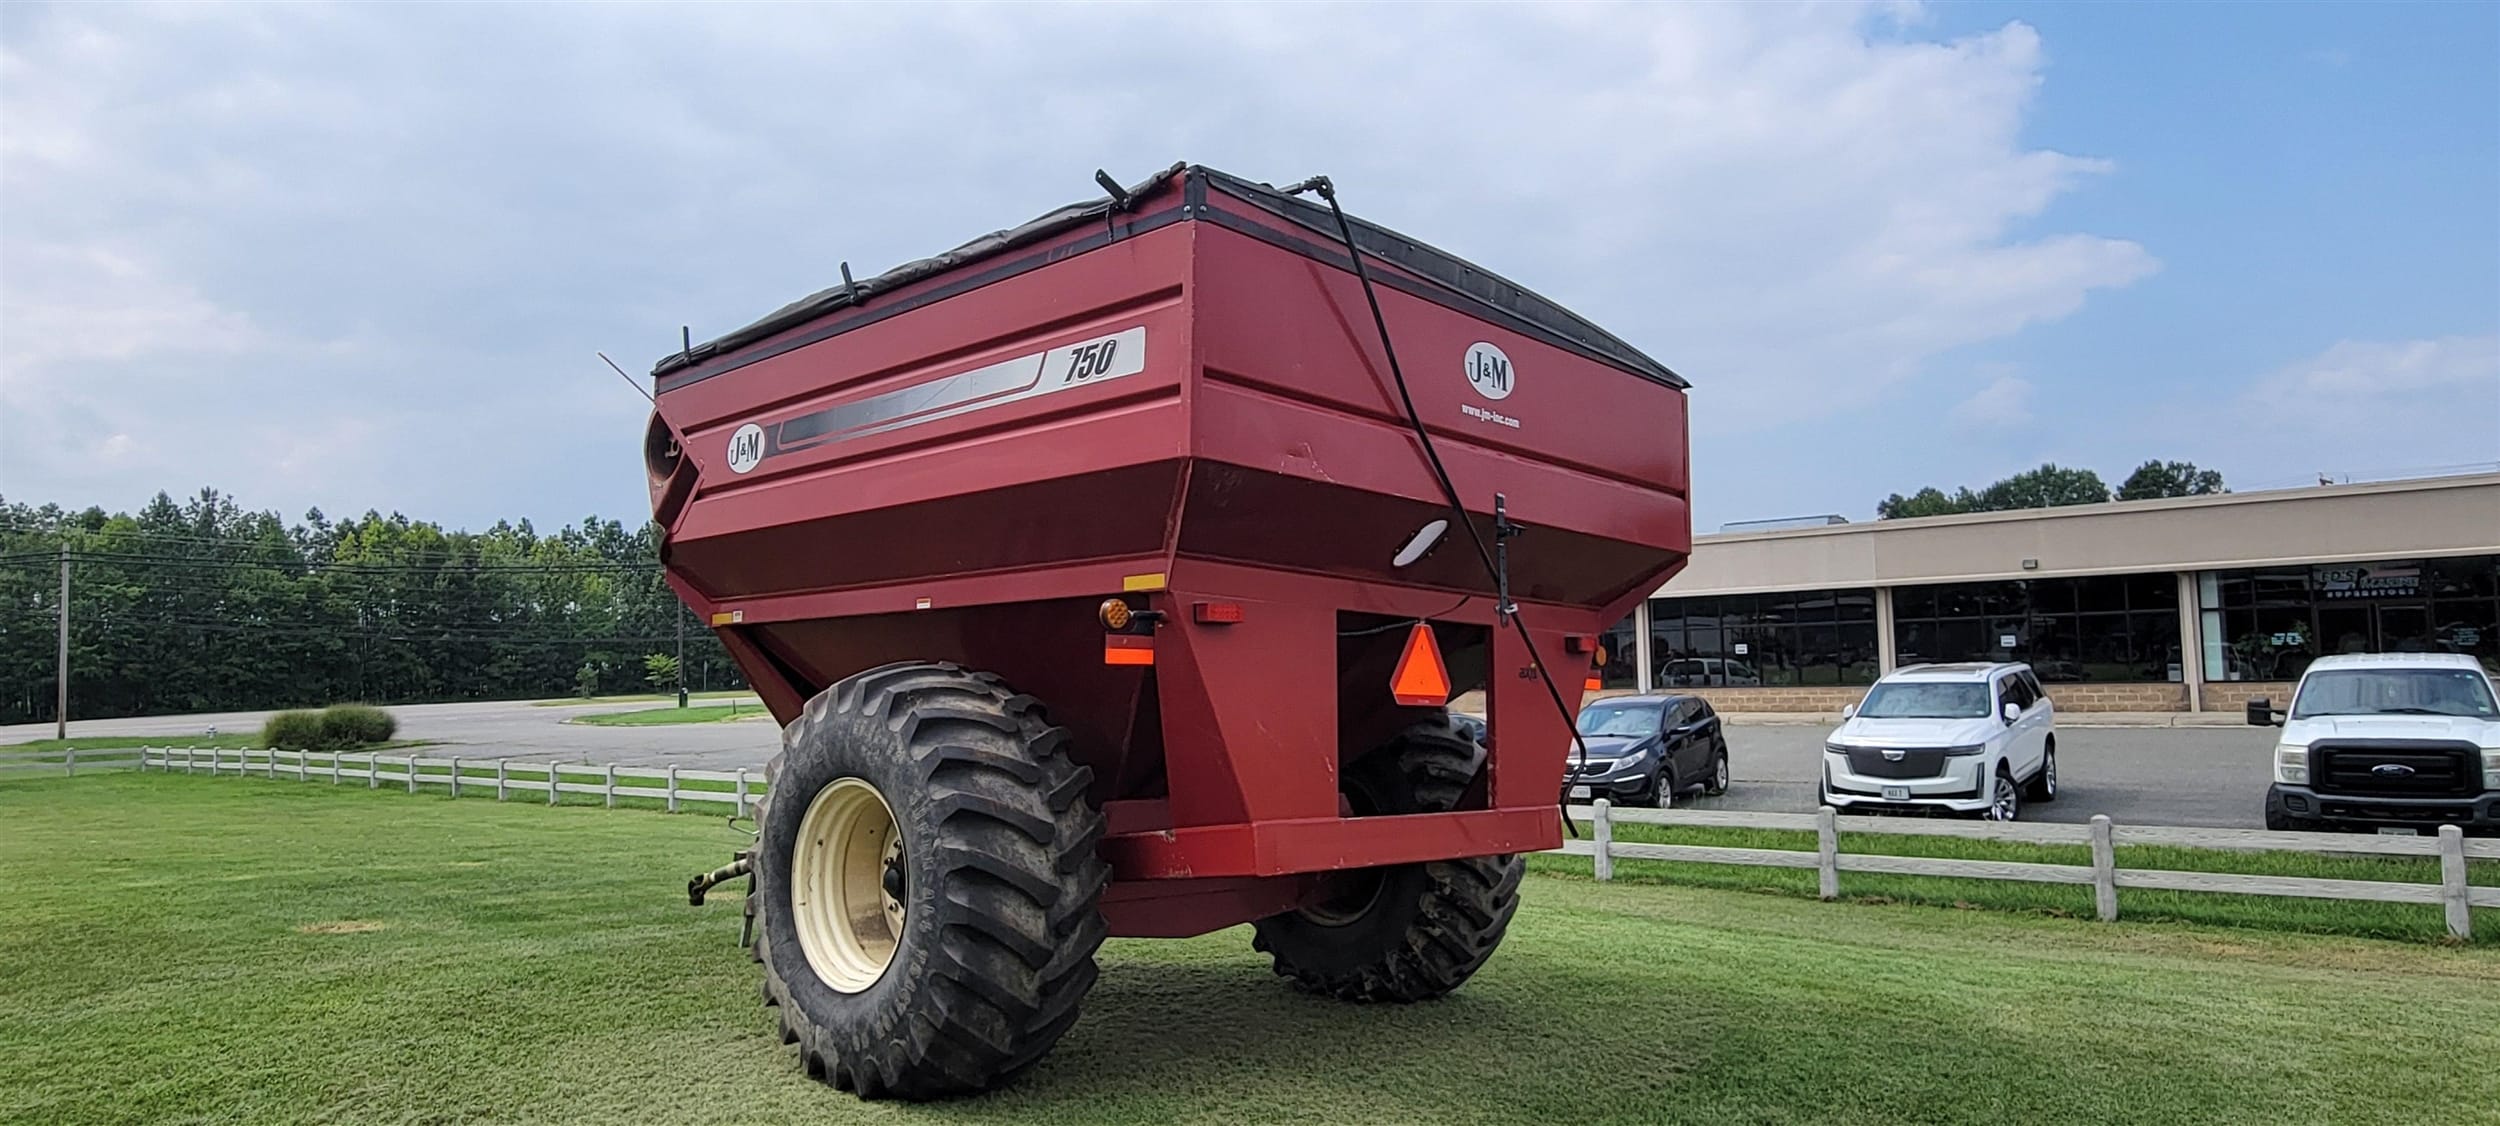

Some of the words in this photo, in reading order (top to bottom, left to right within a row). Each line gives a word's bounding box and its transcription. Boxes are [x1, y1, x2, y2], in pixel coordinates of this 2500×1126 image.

[1063, 339, 1118, 384] 750
[1467, 350, 1508, 393] J&M
[1461, 403, 1520, 429] www.jm-inc.com
[730, 431, 761, 466] J&M
